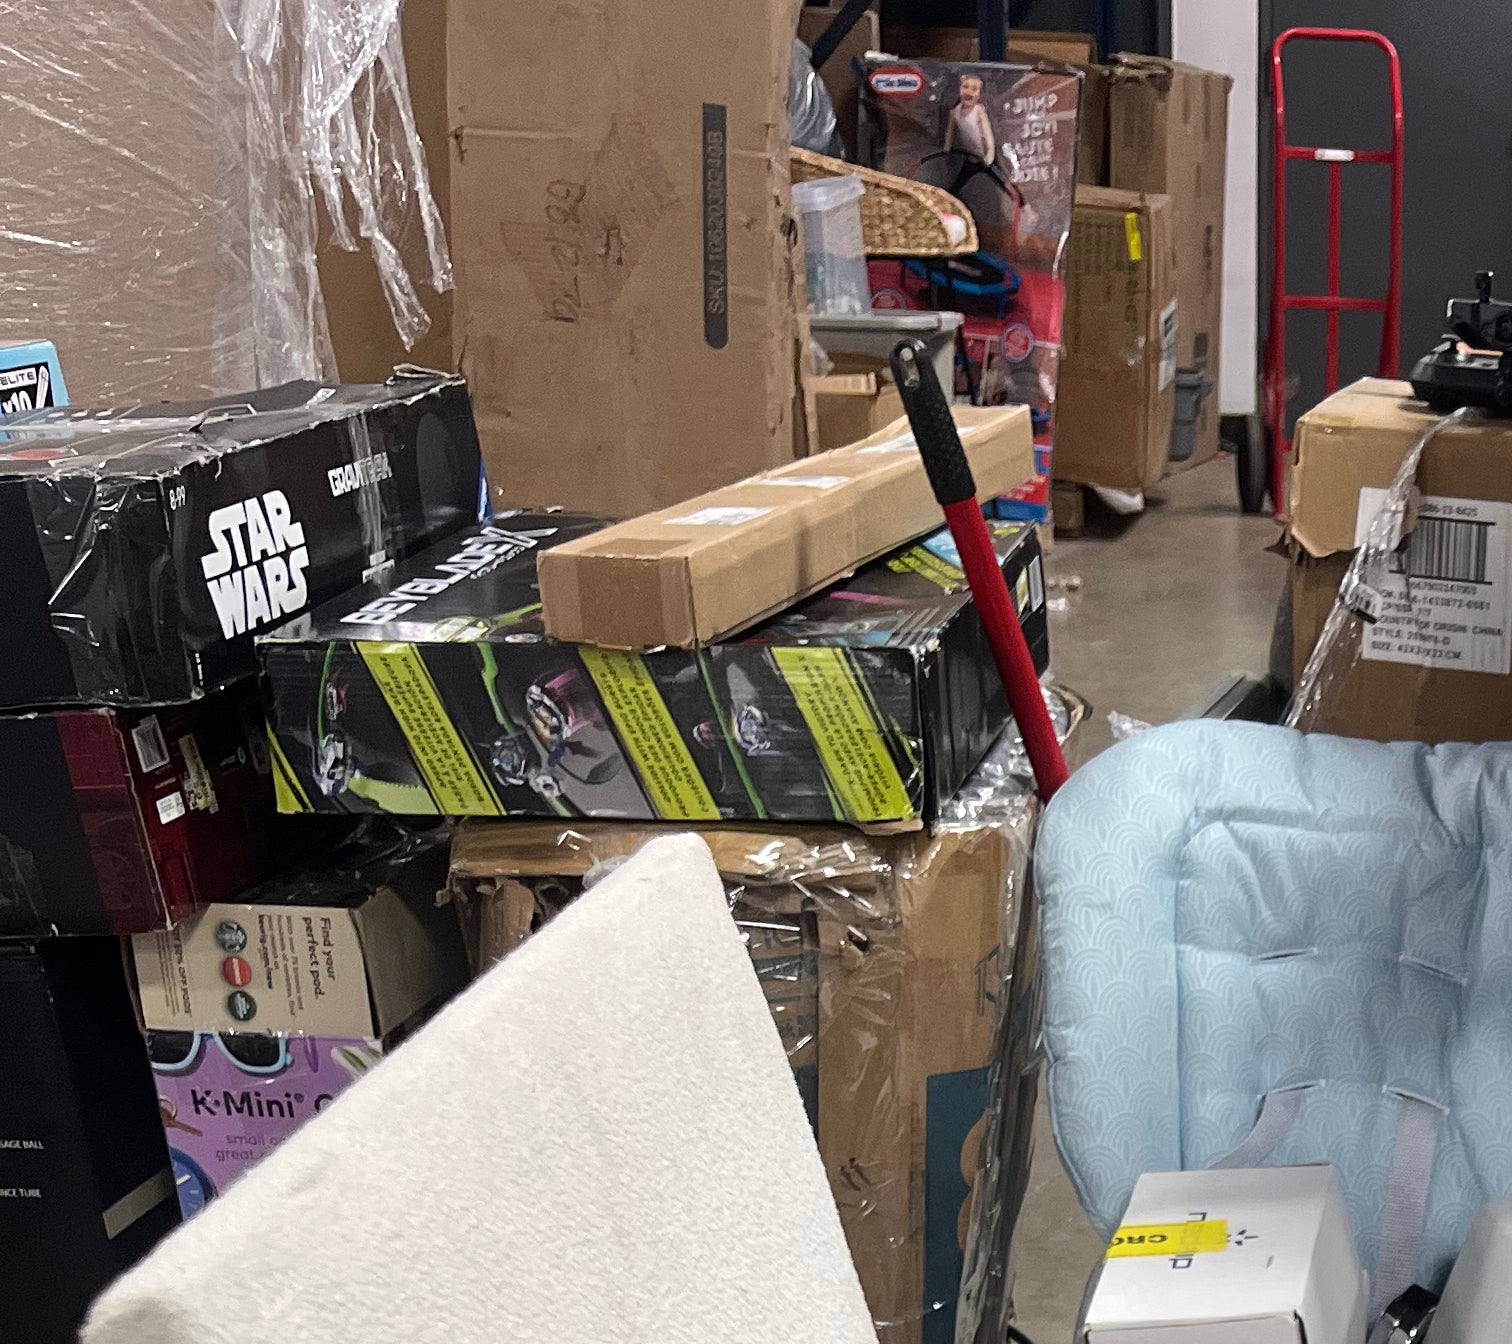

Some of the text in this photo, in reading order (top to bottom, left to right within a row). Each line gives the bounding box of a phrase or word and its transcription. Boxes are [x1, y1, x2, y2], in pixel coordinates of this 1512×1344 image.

[708, 270, 724, 315] SKU
[169, 486, 186, 510] 8-99
[201, 489, 305, 579] STAR
[206, 546, 310, 640] WARS
[340, 538, 512, 624] BEYBLADE
[1433, 622, 1467, 633] ORIGIN
[1472, 625, 1503, 636] CHINA
[302, 916, 325, 999] perfect pod.
[319, 916, 336, 982] Find your
[0, 1139, 44, 1149] SAGE BALL
[215, 1149, 254, 1162] great
[226, 1134, 265, 1146] small
[18, 1188, 42, 1198] TUBE
